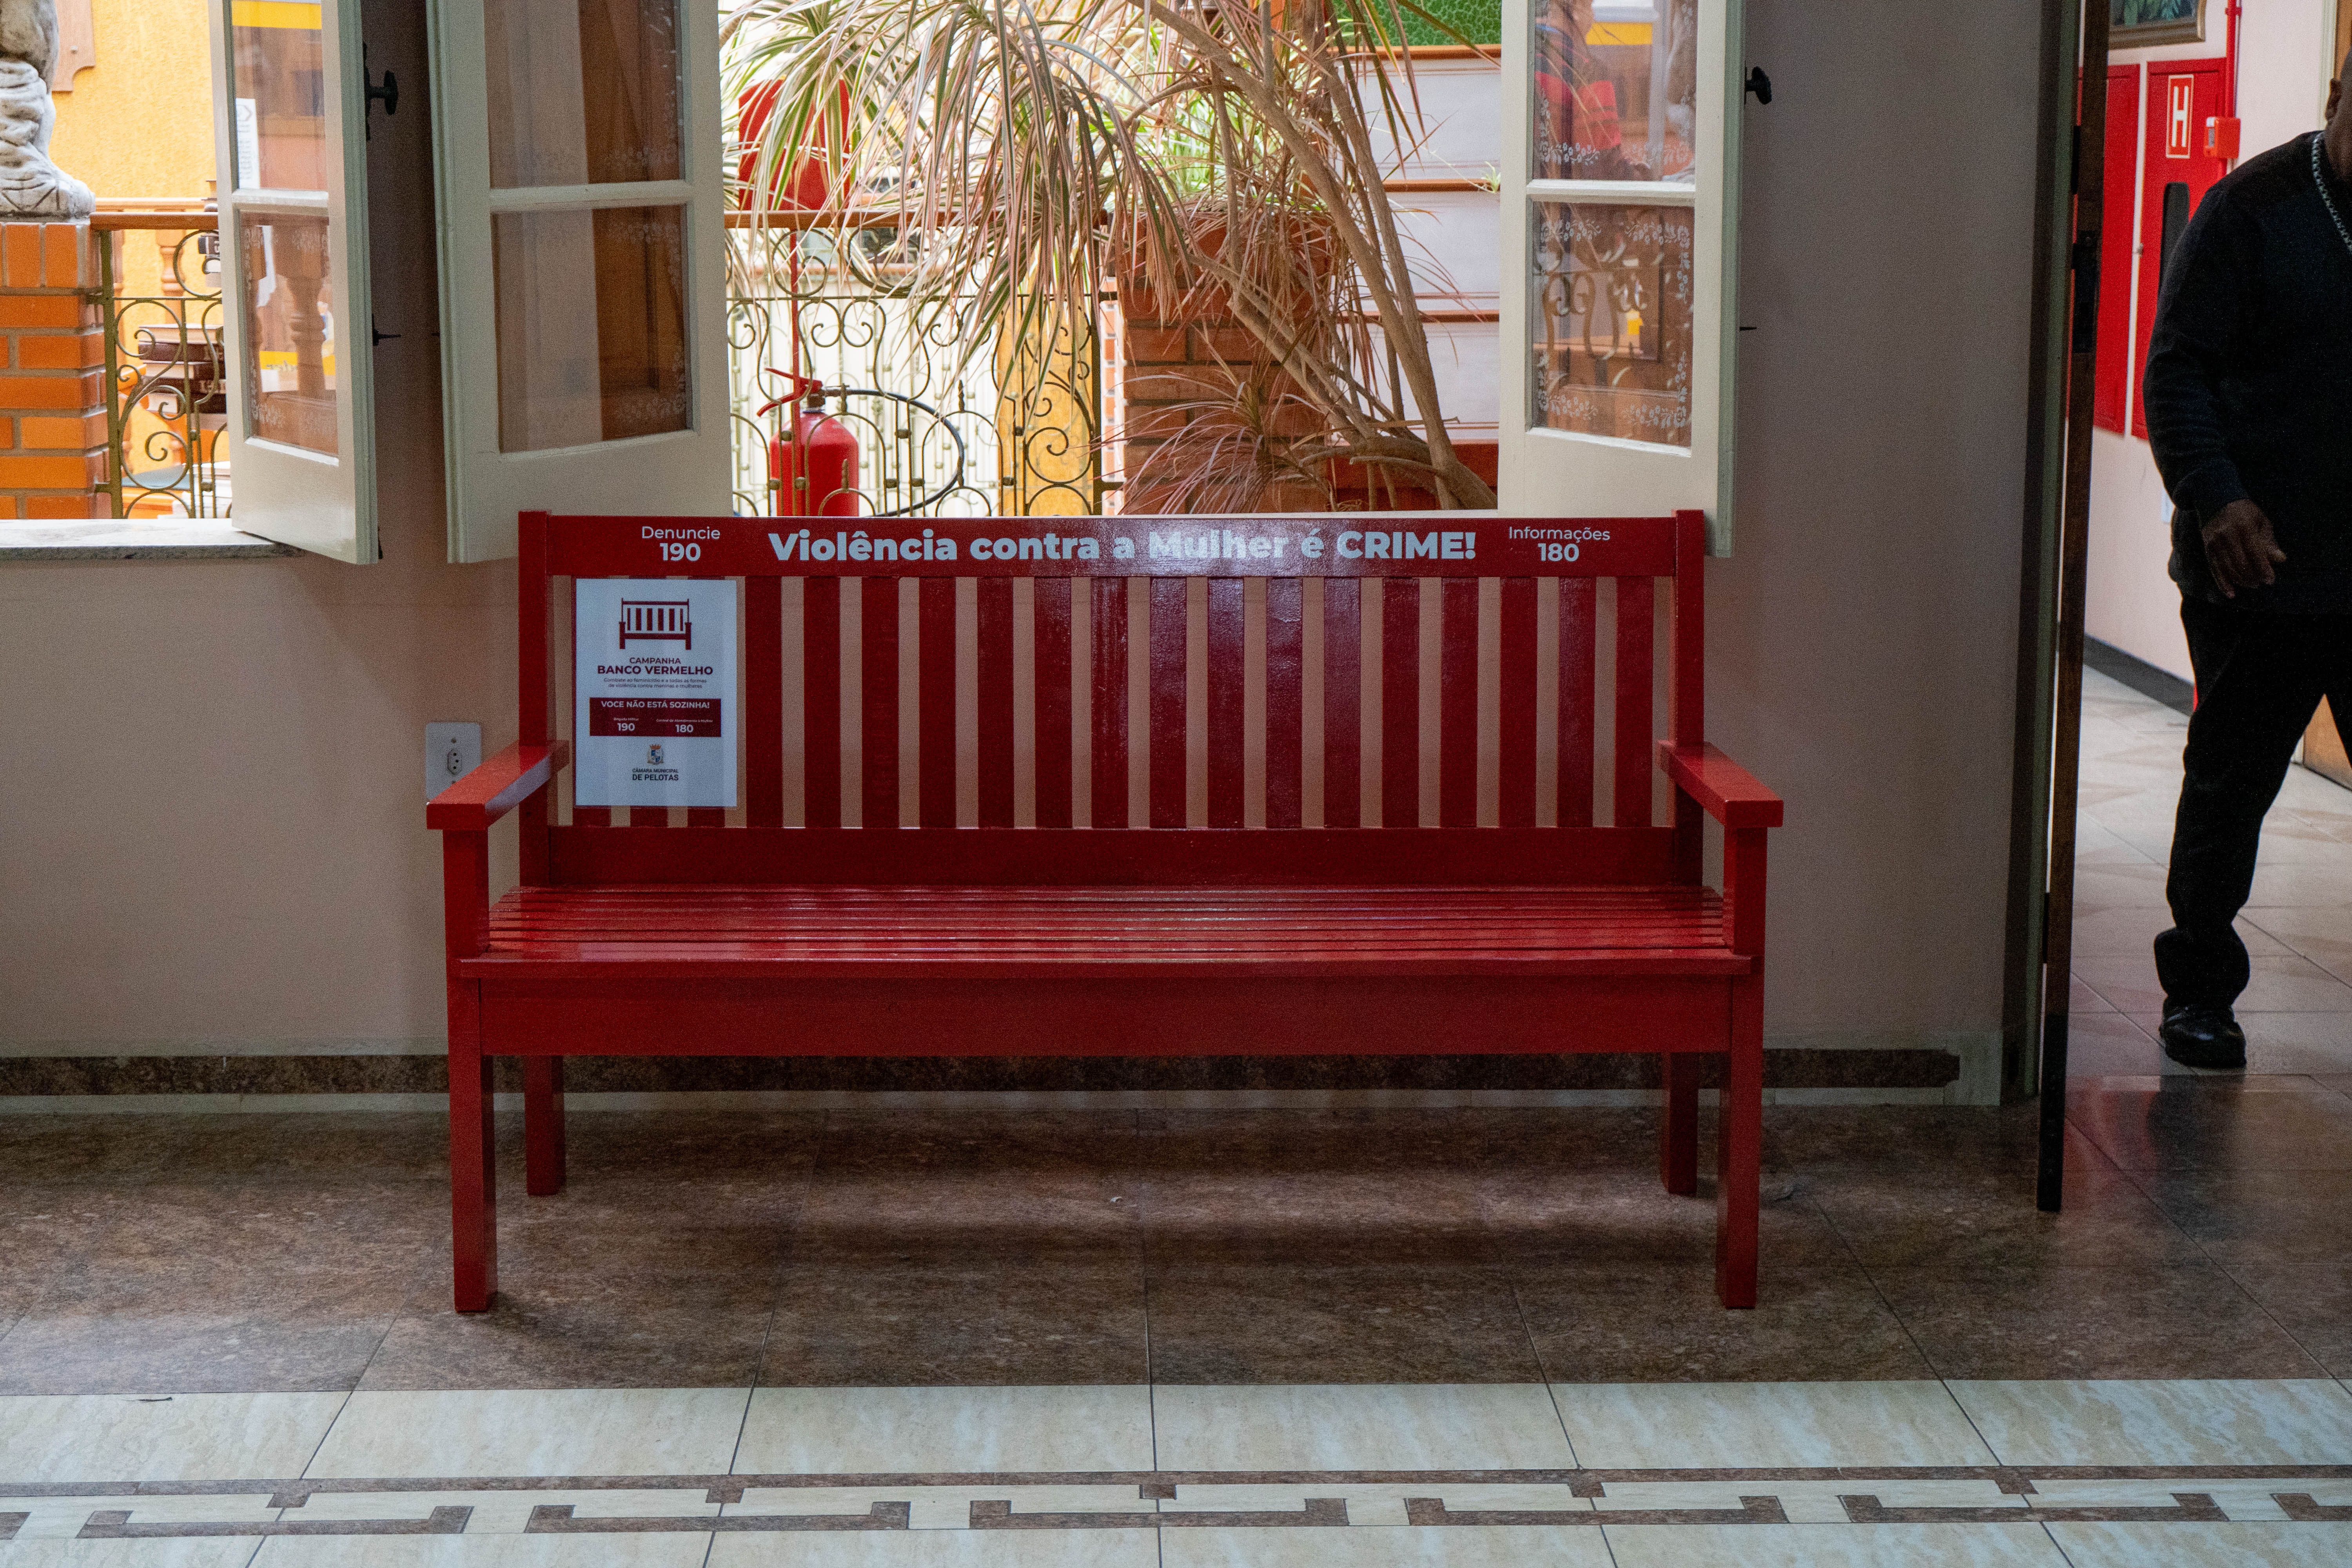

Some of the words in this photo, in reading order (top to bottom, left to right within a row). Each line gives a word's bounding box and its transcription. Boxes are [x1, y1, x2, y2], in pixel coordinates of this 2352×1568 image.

[2171, 86, 2189, 147] H
[642, 526, 720, 539] Denuncie
[1509, 526, 1611, 543] Informações
[660, 543, 701, 561] 190
[768, 529, 957, 561] Violência
[970, 533, 1099, 560] contra
[1113, 536, 1135, 559] a
[1149, 530, 1289, 559] Mulher
[1301, 528, 1325, 559] é
[1336, 530, 1476, 560] CRIME!
[1538, 543, 1579, 562] 180
[597, 665, 641, 674] BANCO
[644, 666, 713, 675] VERMELHO
[617, 722, 635, 731] 190
[675, 724, 694, 733] 180
